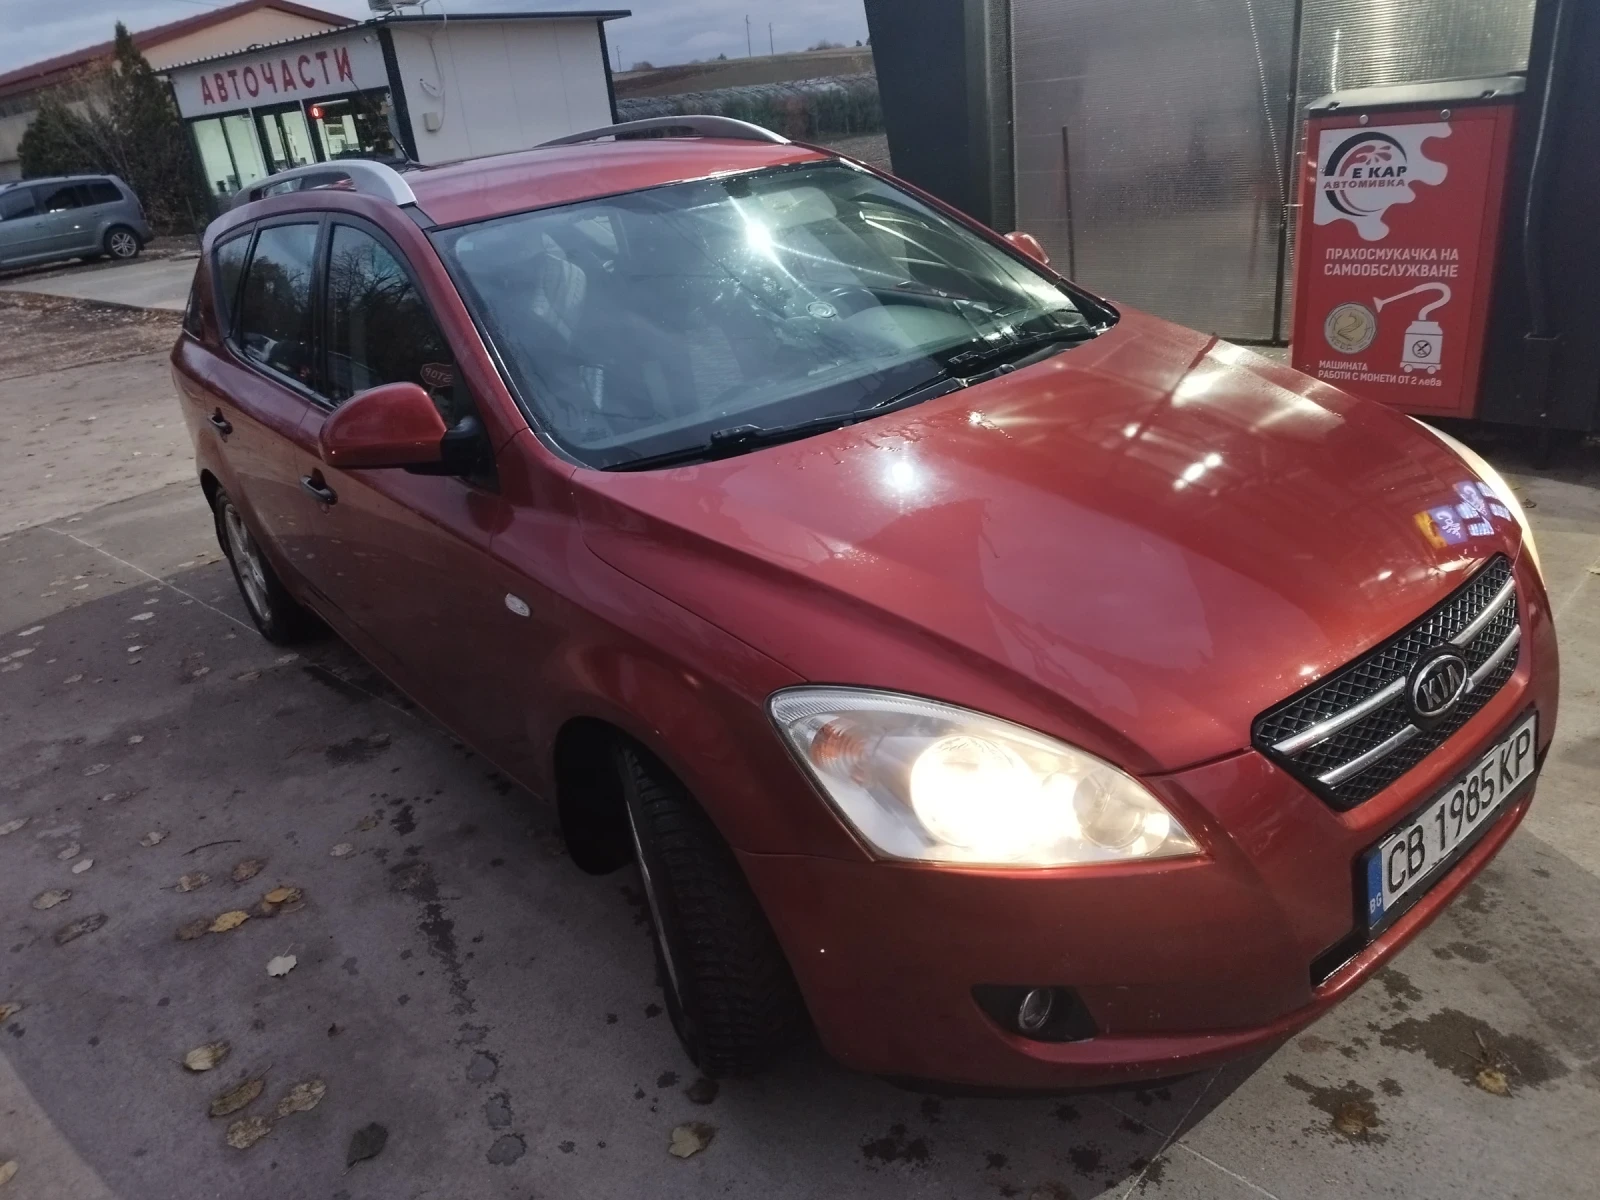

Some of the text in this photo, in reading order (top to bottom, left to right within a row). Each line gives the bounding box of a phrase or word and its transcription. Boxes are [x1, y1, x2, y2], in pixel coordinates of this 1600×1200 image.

[200, 47, 353, 105] АВТОЧАСТИ
[1368, 166, 1407, 178] КАР
[1323, 179, 1405, 189] АВТОМИВКА
[1326, 248, 1459, 261] ПРАХОСМУКАЧКА НА
[1324, 263, 1459, 277] САМООБСЛУЖВАНЕ
[1319, 360, 1368, 371] МАШИНАТА
[1318, 370, 1442, 387] РАБОТИ С МОНЕТИ ОТ 2 лева
[1420, 664, 1462, 709] KIA
[1387, 727, 1531, 894] CB 1985 KP
[1369, 894, 1382, 914] BG
